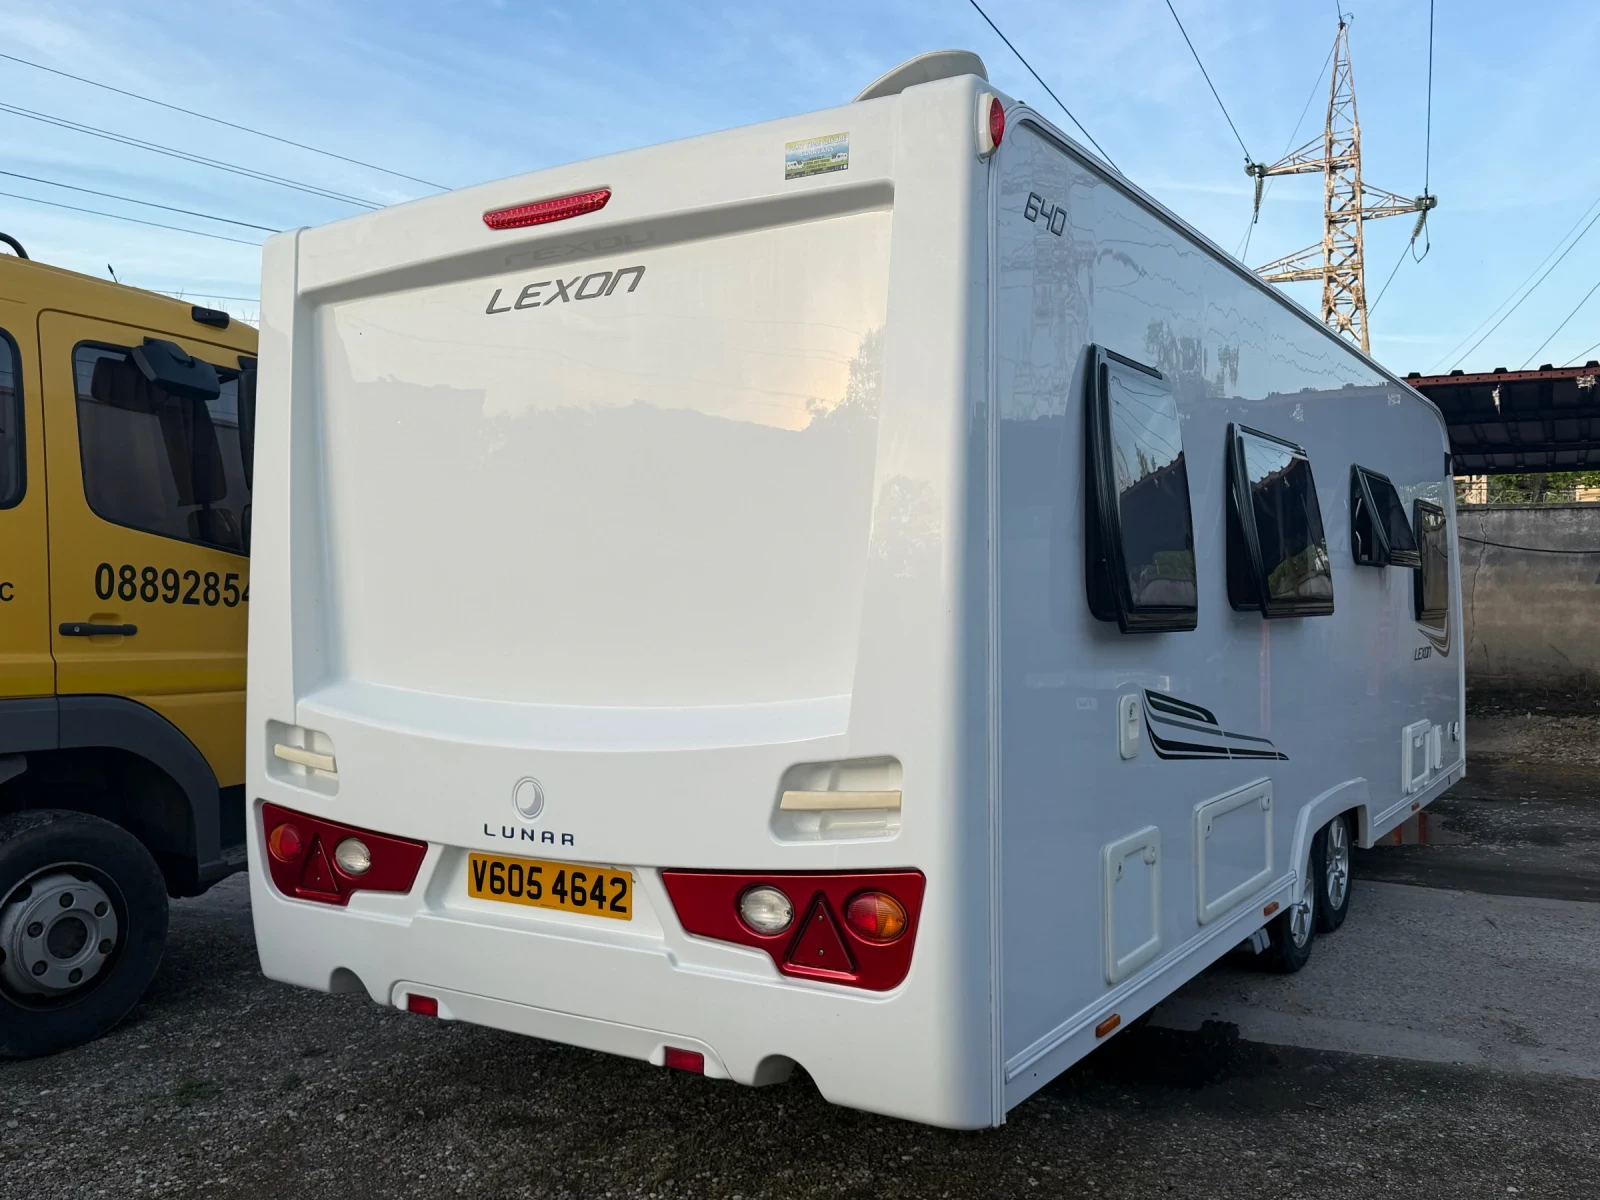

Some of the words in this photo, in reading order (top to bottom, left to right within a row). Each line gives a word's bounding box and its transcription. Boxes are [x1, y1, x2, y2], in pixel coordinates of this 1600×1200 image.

[1024, 191, 1067, 237] 640
[485, 266, 645, 315] LEXON
[484, 823, 574, 846] LUNAR
[473, 860, 542, 900] V605
[552, 870, 627, 913] 4642
